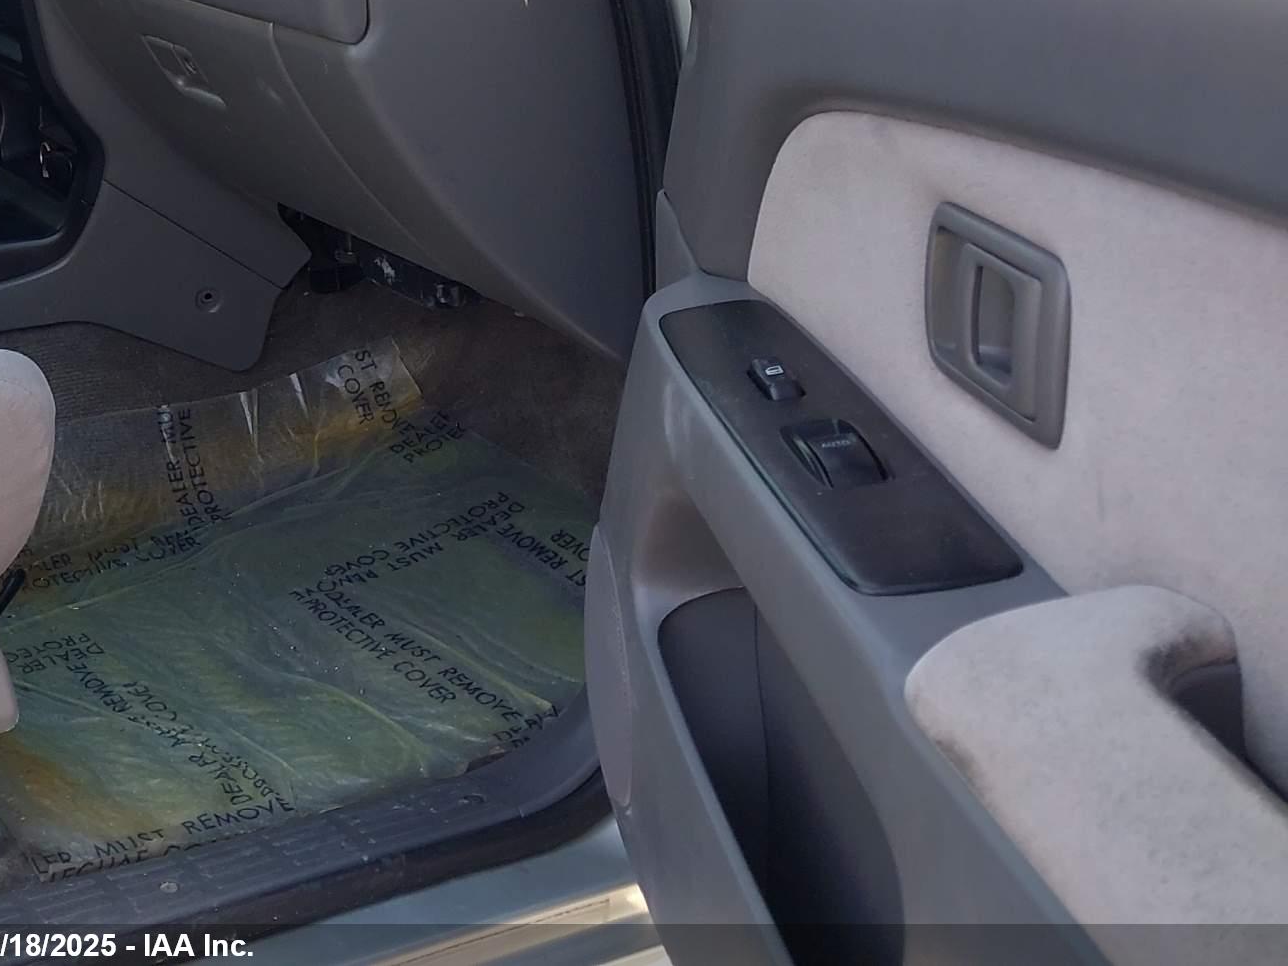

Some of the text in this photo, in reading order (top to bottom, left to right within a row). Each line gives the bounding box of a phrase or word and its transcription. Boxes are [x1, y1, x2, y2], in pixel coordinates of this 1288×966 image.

[338, 365, 374, 424] COVER
[393, 492, 510, 552] PROTECTIVE
[457, 502, 525, 542] DEALER
[387, 542, 443, 572] MUST
[497, 523, 565, 570] REMOVE
[18, 644, 105, 674] DEALER
[385, 632, 441, 663] MUST
[438, 666, 522, 723] REMOVE
[67, 664, 130, 713] REMOVE
[393, 661, 457, 704] COVER
[183, 797, 295, 835] REMOVE
